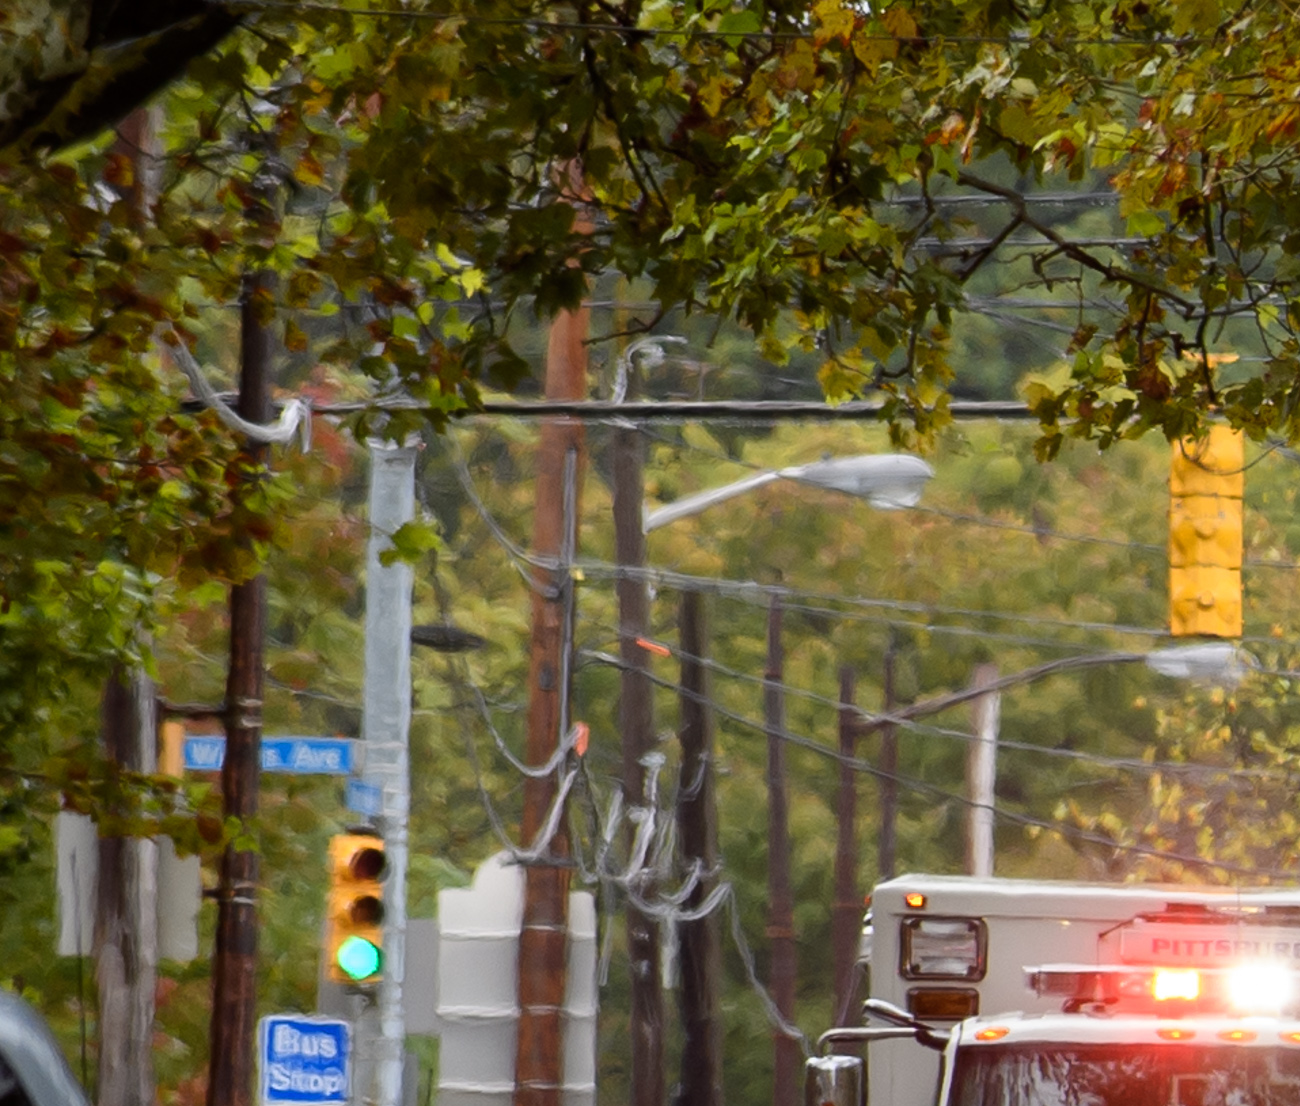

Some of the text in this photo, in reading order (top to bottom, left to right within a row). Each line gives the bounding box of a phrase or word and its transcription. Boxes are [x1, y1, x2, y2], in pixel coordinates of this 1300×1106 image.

[296, 744, 340, 769] Ave
[273, 1024, 338, 1058] Bus
[270, 1063, 344, 1096] Stop
